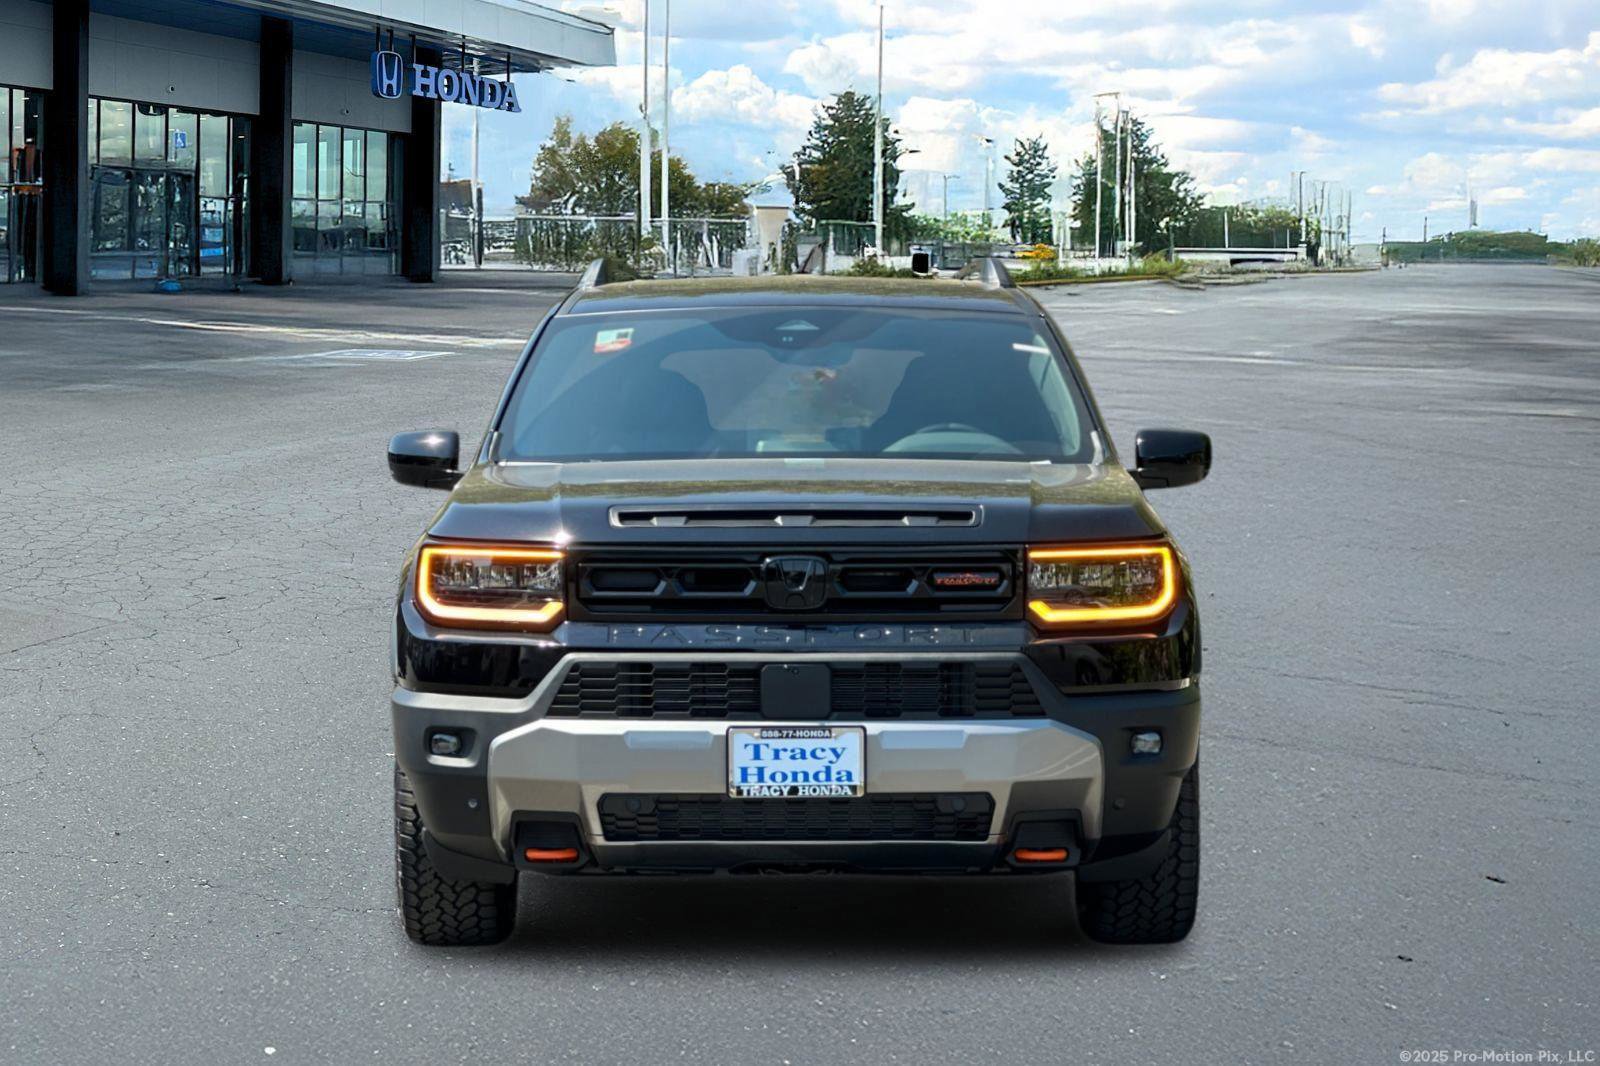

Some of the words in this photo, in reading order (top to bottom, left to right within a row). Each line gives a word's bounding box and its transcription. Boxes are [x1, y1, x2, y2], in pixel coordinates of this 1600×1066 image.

[412, 63, 521, 112] HONDA
[601, 624, 980, 643] PASSPORT
[744, 743, 846, 764] Tracy
[739, 765, 853, 783] Honda
[741, 786, 790, 796] TRACY
[799, 786, 852, 796] HONDA
